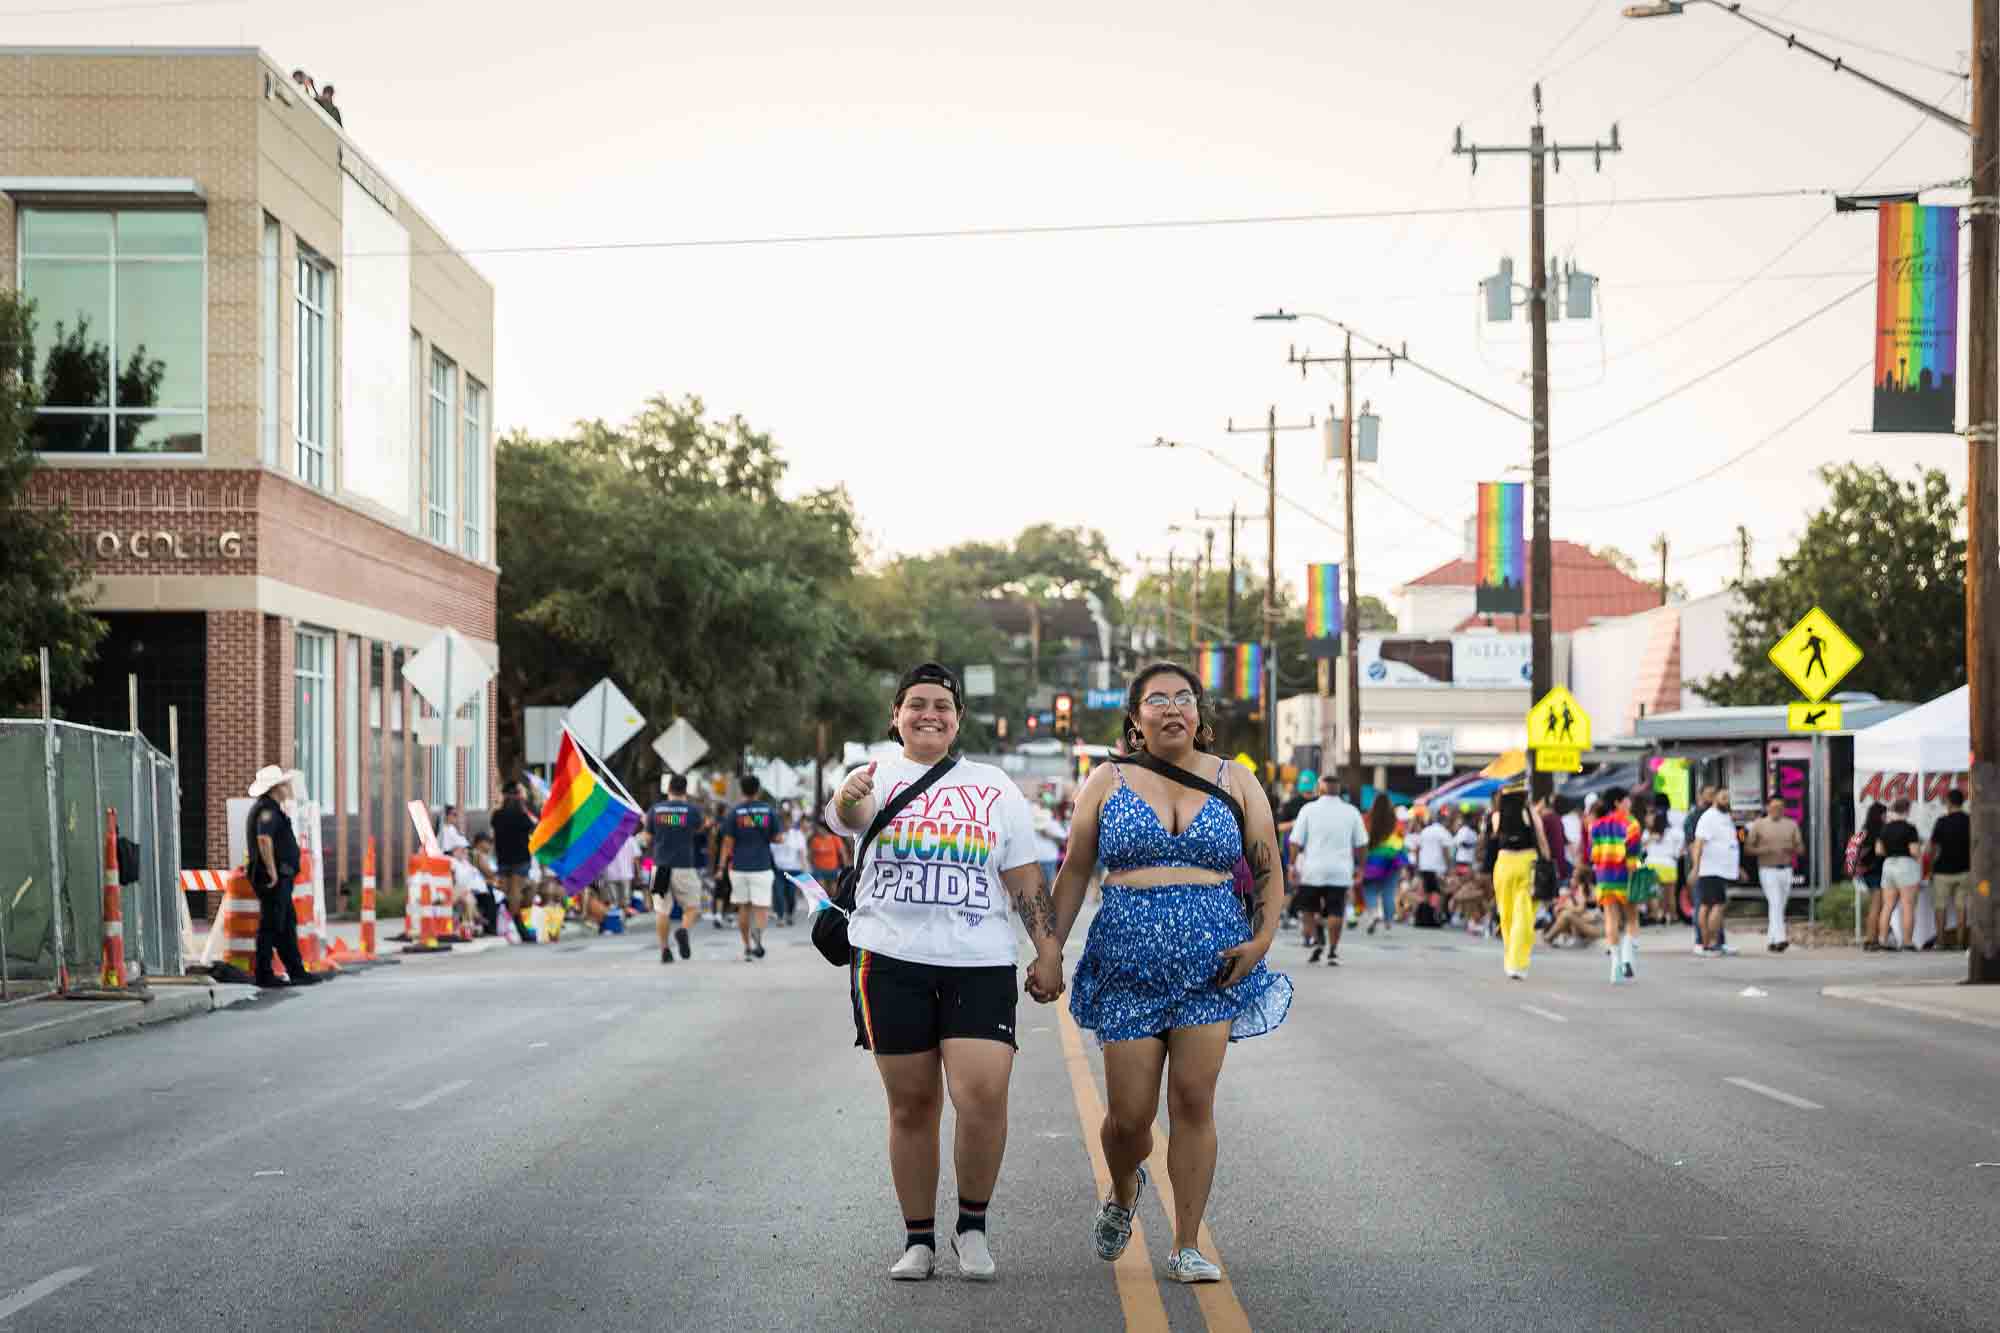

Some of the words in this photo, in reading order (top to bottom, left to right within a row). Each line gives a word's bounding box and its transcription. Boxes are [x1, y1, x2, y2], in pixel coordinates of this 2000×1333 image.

[1420, 751, 1449, 769] 30
[885, 781, 1001, 826] GAY
[872, 861, 990, 910] PRIDE
